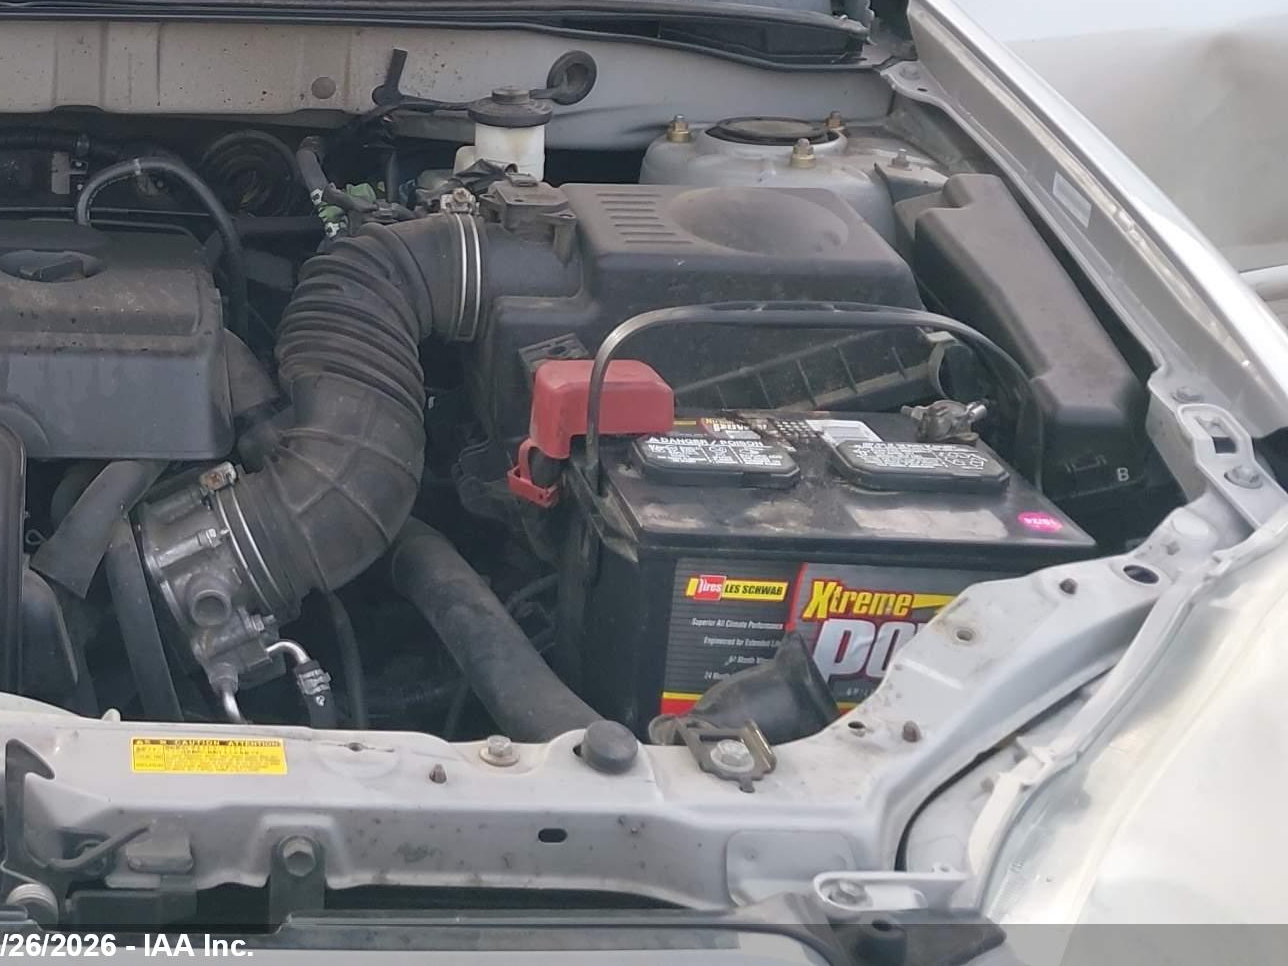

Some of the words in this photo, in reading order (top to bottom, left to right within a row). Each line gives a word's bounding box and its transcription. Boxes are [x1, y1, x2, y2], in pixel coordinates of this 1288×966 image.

[659, 436, 709, 446] DANGER
[1116, 467, 1130, 481] B
[724, 584, 741, 594] LES
[742, 585, 784, 596] SCHWAB
[802, 580, 913, 619] Xtreme
[691, 617, 716, 627] Superior
